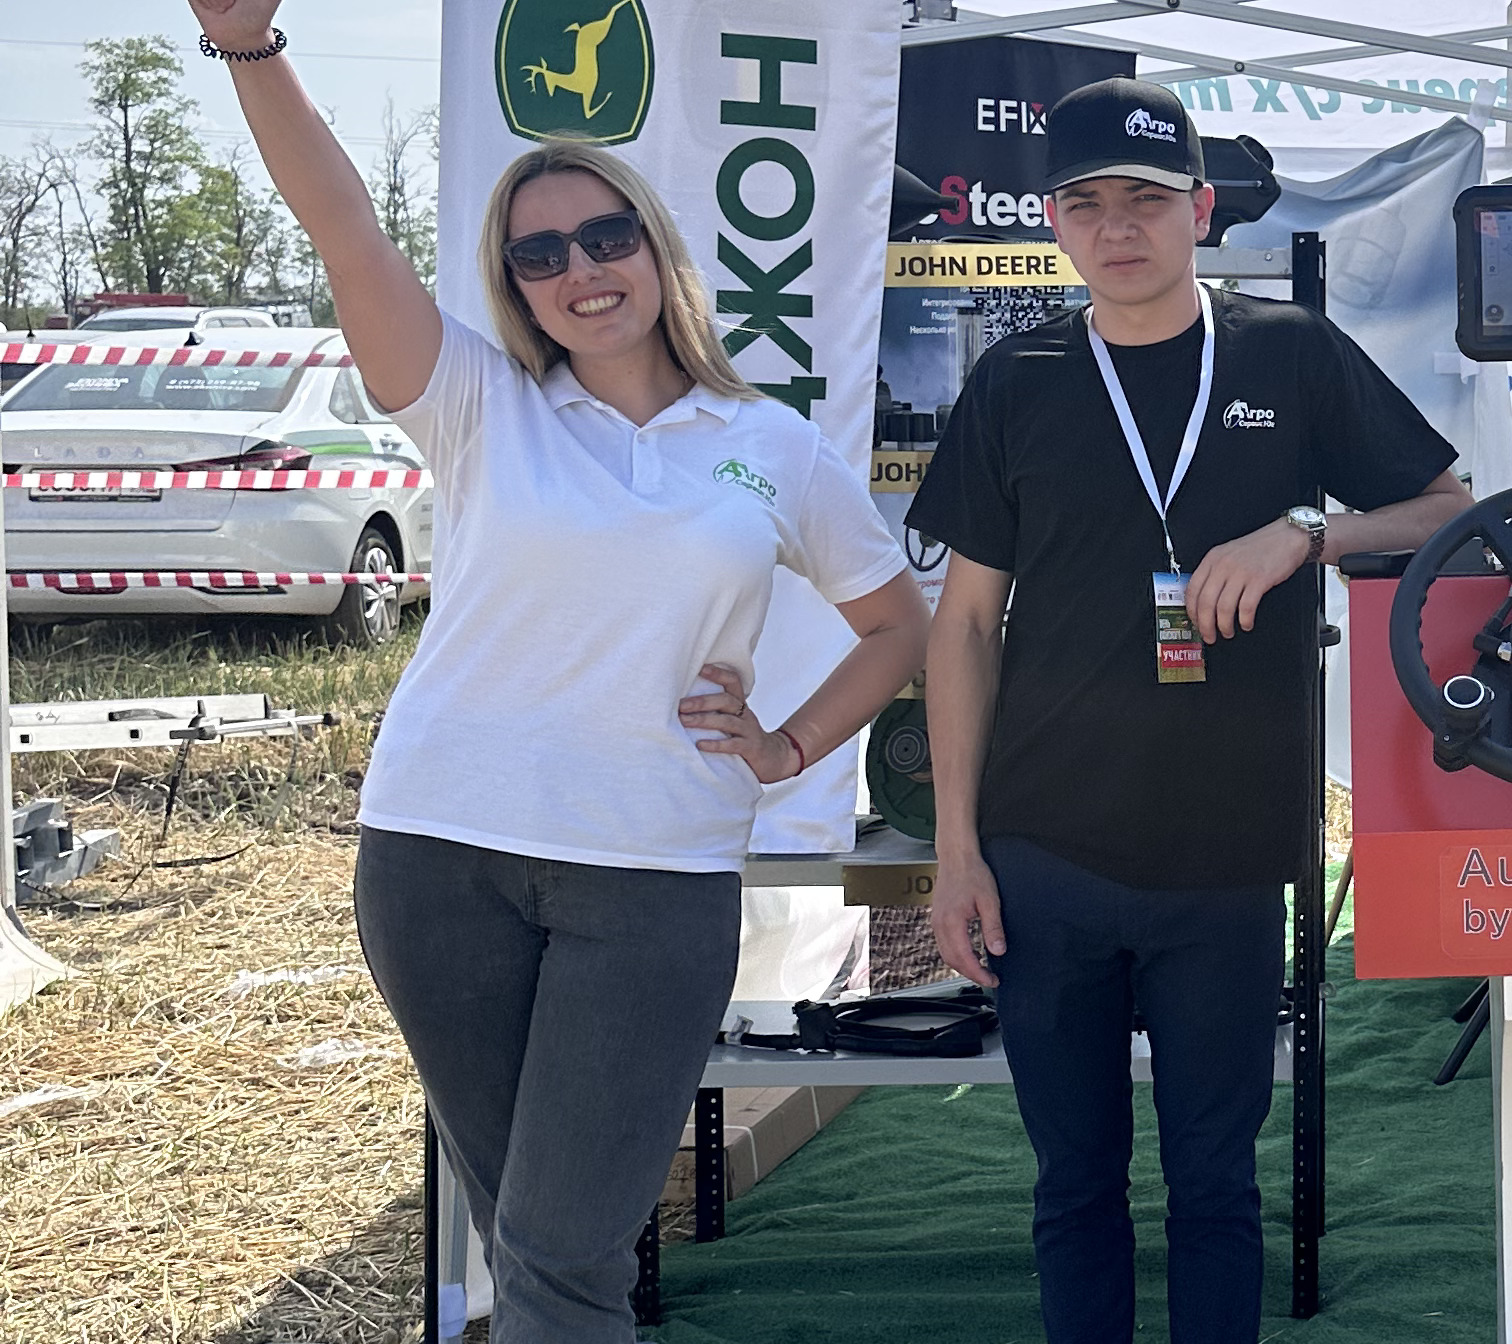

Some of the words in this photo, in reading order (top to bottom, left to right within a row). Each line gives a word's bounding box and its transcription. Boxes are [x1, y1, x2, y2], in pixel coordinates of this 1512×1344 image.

[977, 97, 1047, 135] EFIX
[894, 256, 968, 277] JOHN
[976, 255, 1058, 276] DEERE
[870, 462, 931, 483] JOH
[1463, 899, 1512, 939] by
